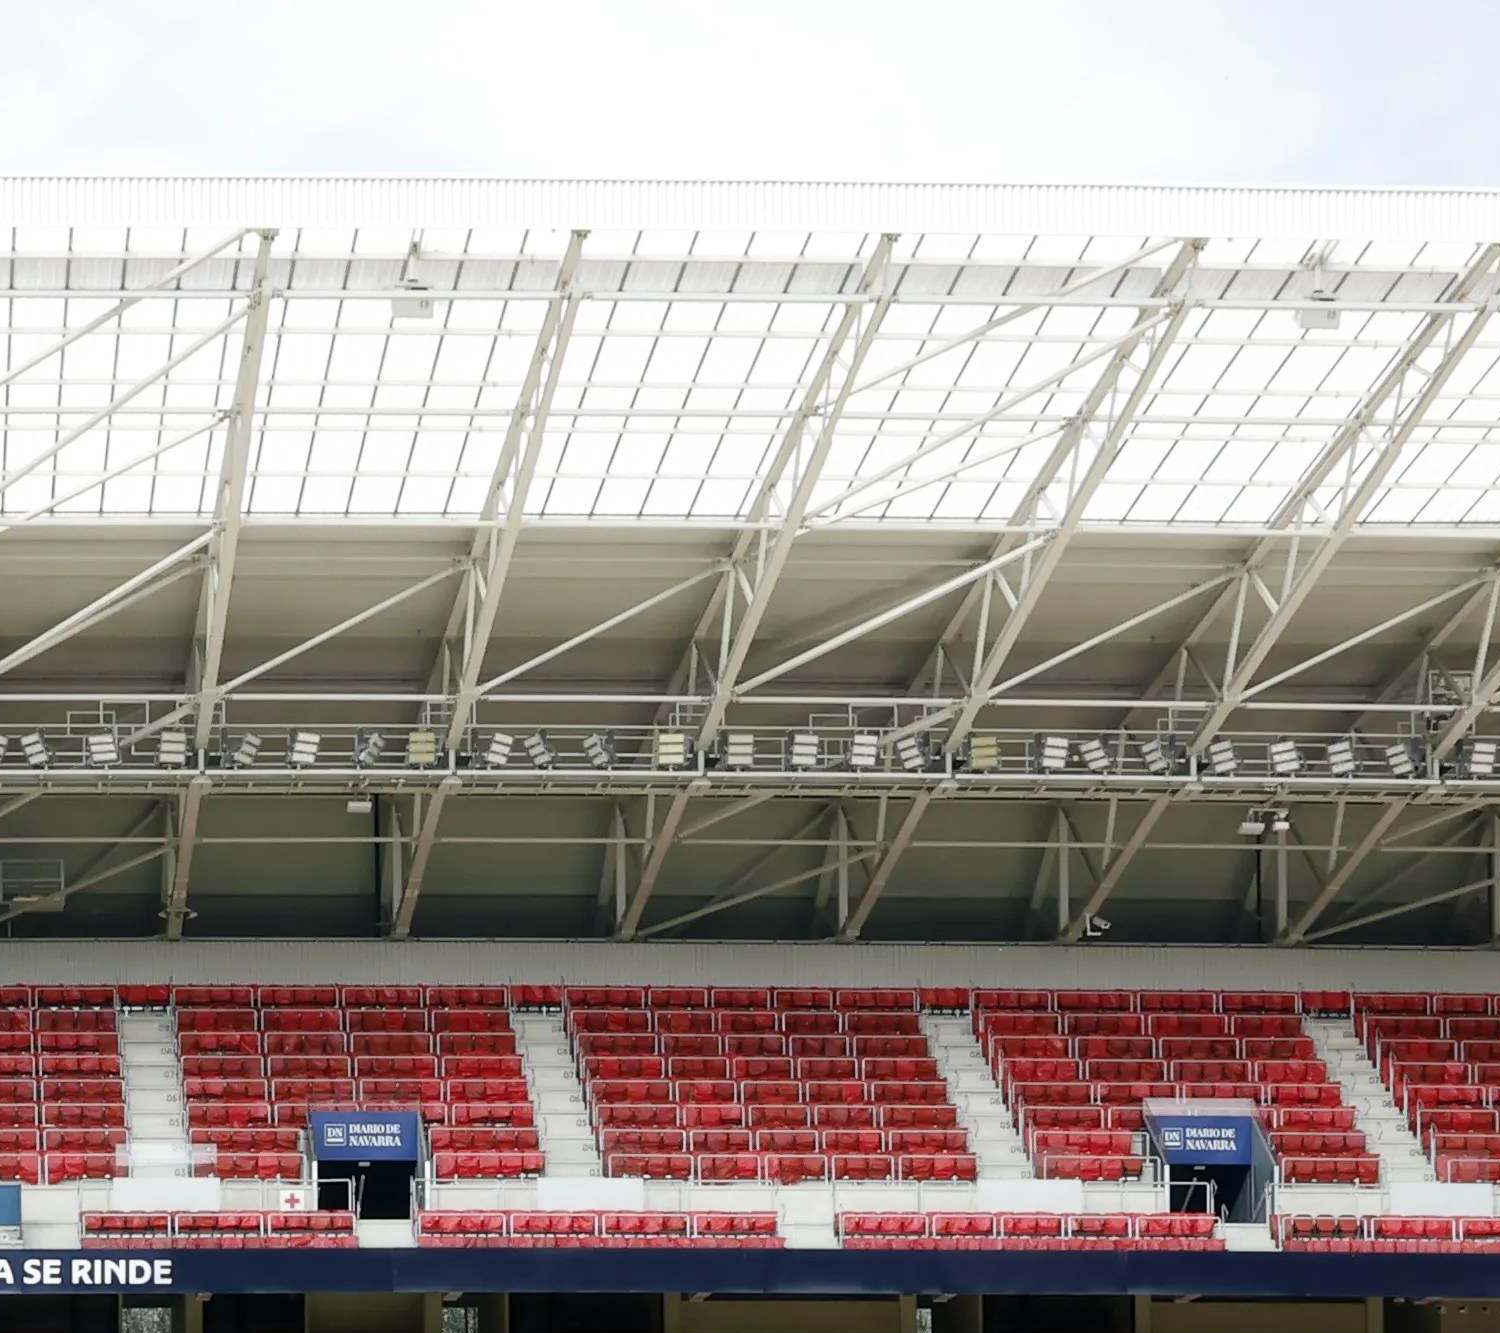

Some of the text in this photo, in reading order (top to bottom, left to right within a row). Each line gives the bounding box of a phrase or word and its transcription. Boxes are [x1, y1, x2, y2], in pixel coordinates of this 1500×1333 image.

[349, 1123, 400, 1134] DIARIO DE
[1186, 1128, 1236, 1138] DIARIO DE
[349, 1136, 401, 1147] NAVARRA
[1186, 1140, 1236, 1150] NAVARRA
[23, 1259, 61, 1285] SE
[71, 1259, 172, 1285] RINDE
